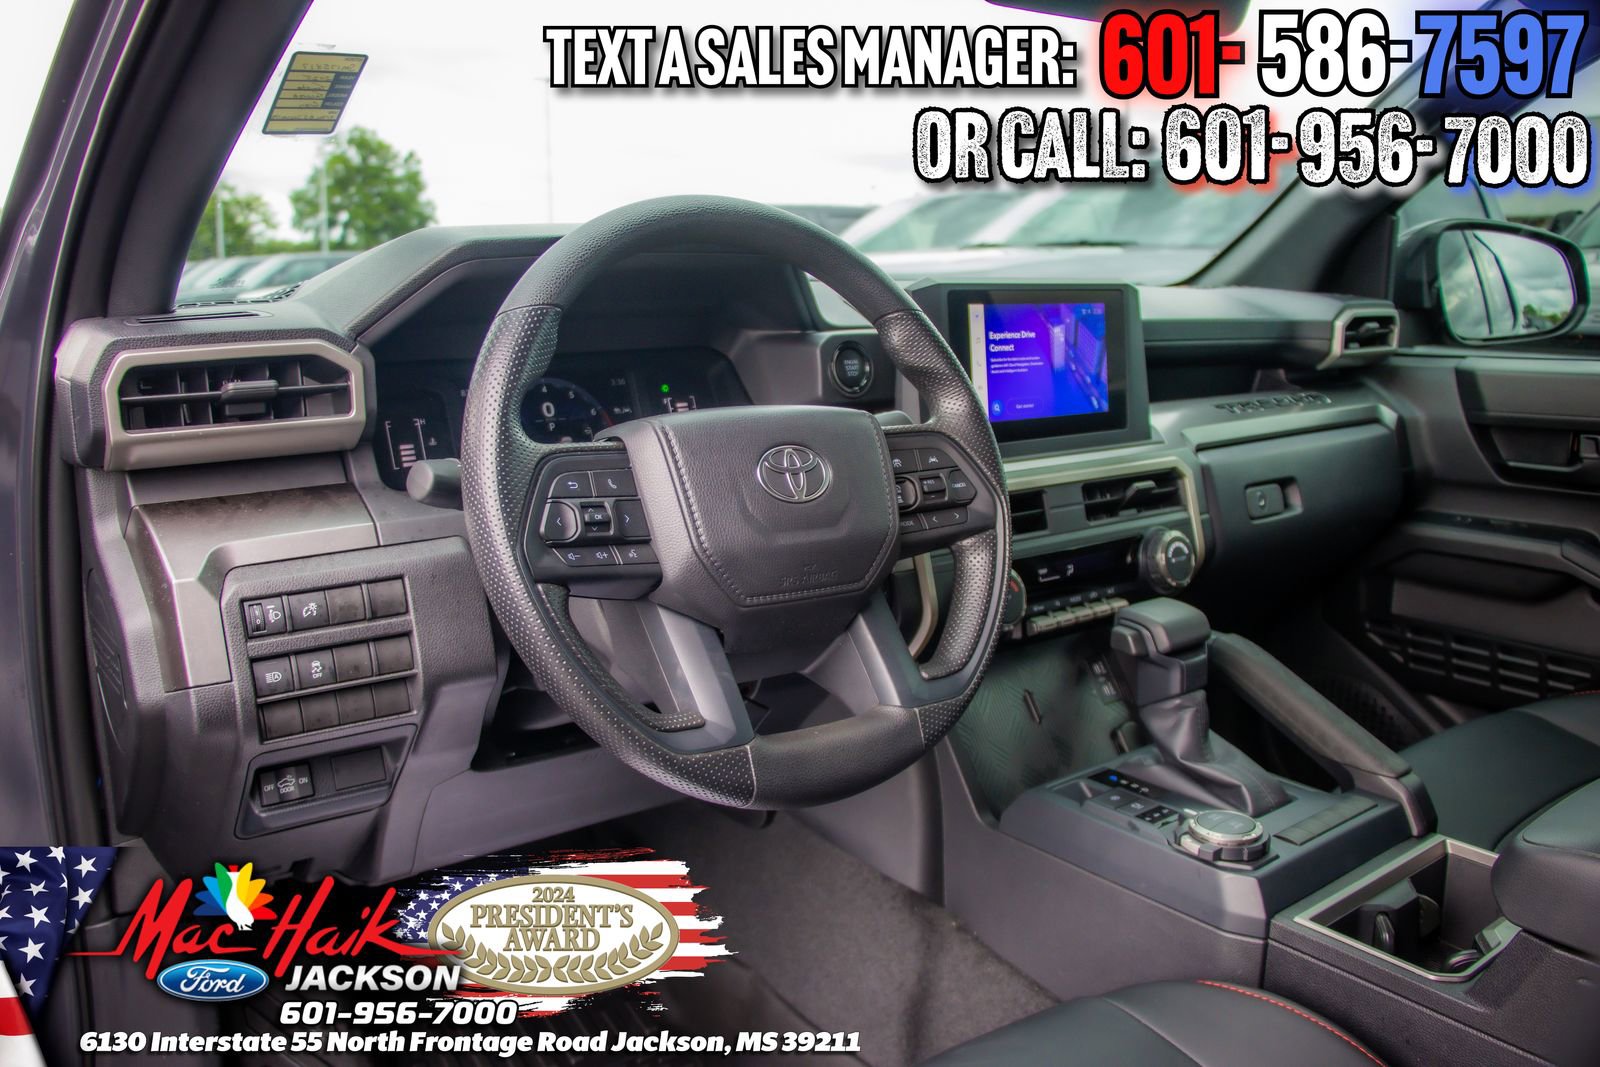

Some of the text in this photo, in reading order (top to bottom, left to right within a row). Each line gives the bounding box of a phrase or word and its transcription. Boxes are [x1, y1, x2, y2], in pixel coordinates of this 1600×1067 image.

[988, 330, 1036, 341] Experience Drive
[988, 343, 1015, 352] Connect
[542, 385, 548, 393] 4
[568, 390, 575, 399] 5
[541, 402, 555, 418] 0
[590, 407, 597, 416] 6
[548, 423, 556, 432] P
[263, 784, 274, 792] OFF
